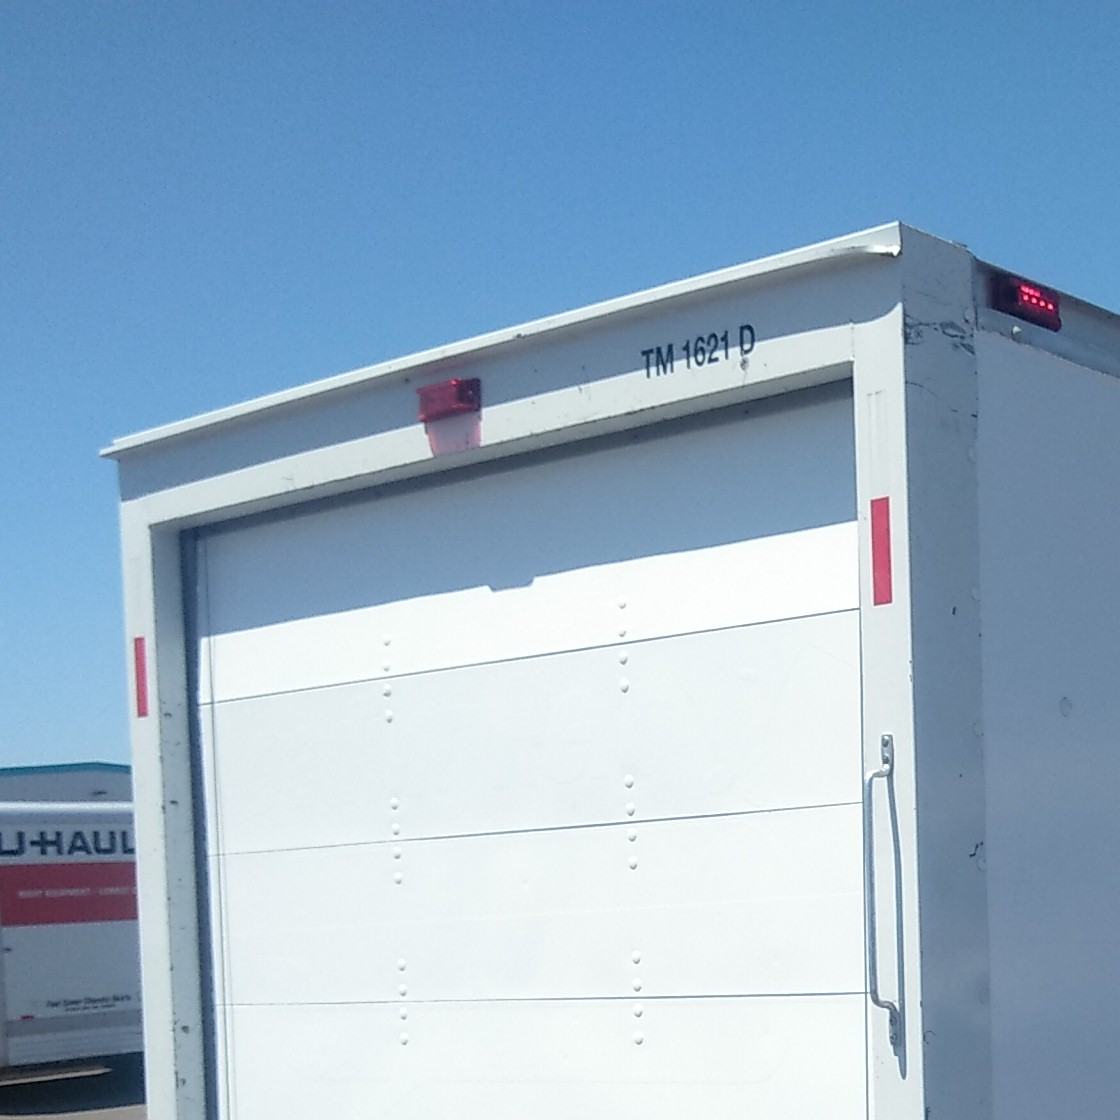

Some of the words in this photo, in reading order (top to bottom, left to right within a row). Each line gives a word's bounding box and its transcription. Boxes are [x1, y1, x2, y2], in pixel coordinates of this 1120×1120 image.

[641, 344, 675, 379] TM
[683, 330, 729, 369] 1621
[739, 324, 755, 356] D
[0, 830, 135, 856] U-HAUL
